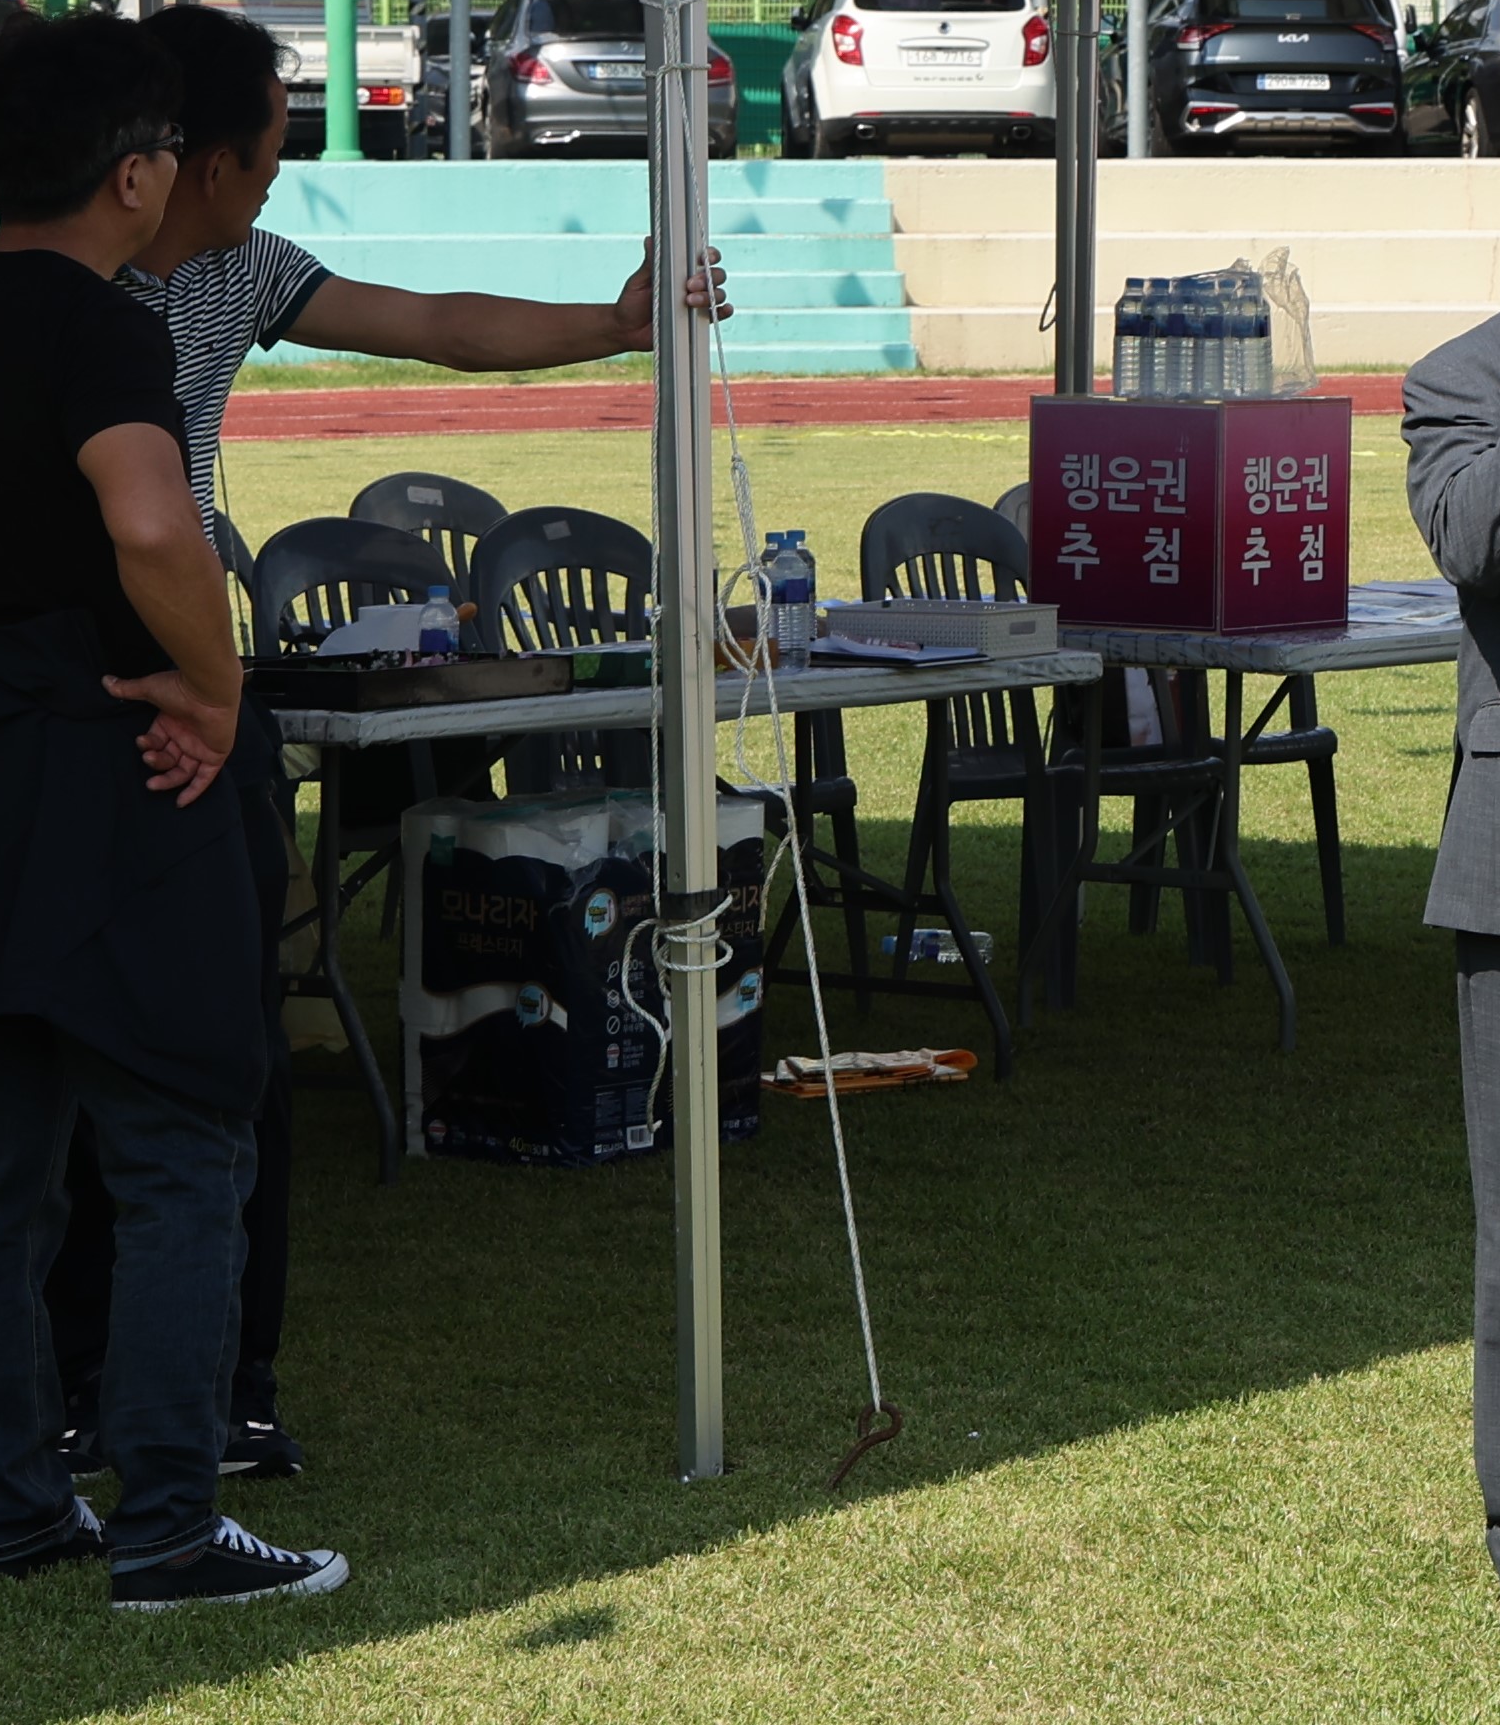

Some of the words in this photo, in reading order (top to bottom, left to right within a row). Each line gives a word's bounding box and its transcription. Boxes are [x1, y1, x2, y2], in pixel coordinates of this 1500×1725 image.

[1059, 453, 1188, 516] 행운권
[1242, 453, 1330, 515] 행운권
[440, 888, 540, 932] 모나리자
[733, 884, 762, 914] 리자
[456, 931, 524, 960] 프레스티지
